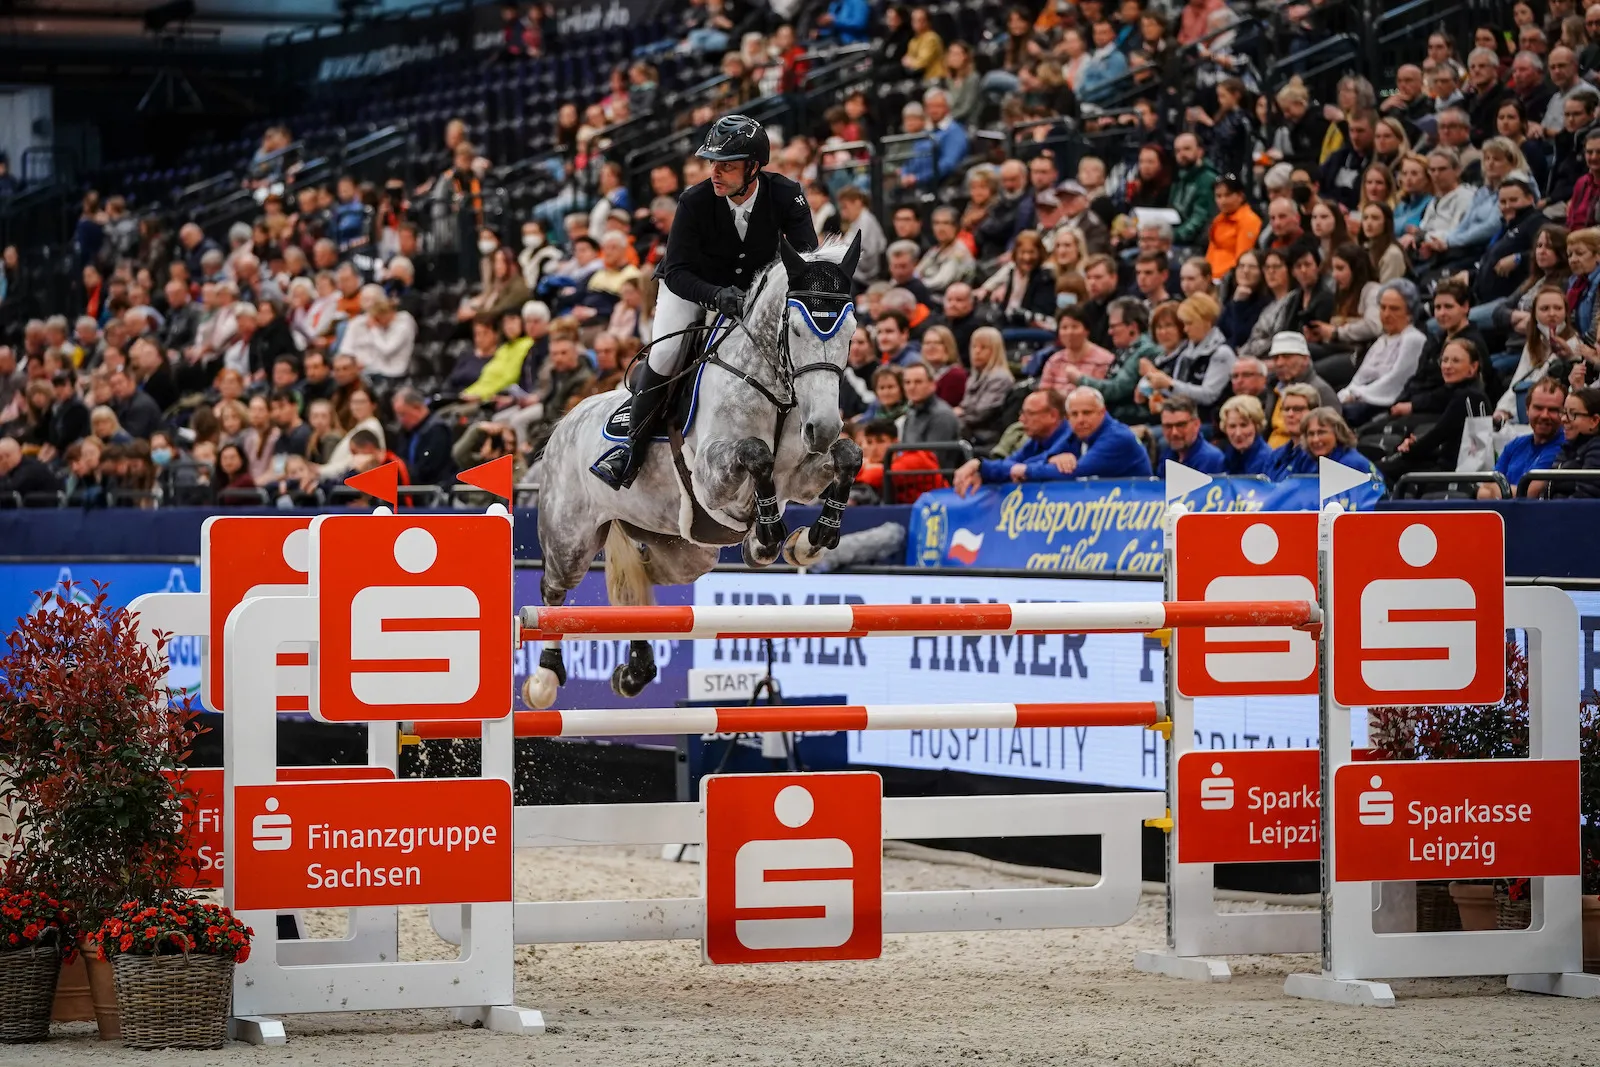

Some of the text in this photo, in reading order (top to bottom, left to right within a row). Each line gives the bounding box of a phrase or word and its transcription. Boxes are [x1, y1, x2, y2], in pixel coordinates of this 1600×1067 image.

[910, 596, 1088, 679] HIRMER
[704, 673, 759, 693] START
[1407, 798, 1532, 831] Sparkasse
[308, 823, 497, 853] Finanzgruppe
[1249, 819, 1321, 849] Leipzi
[1409, 836, 1496, 866] Leipzig
[306, 861, 421, 889] Sachsen
